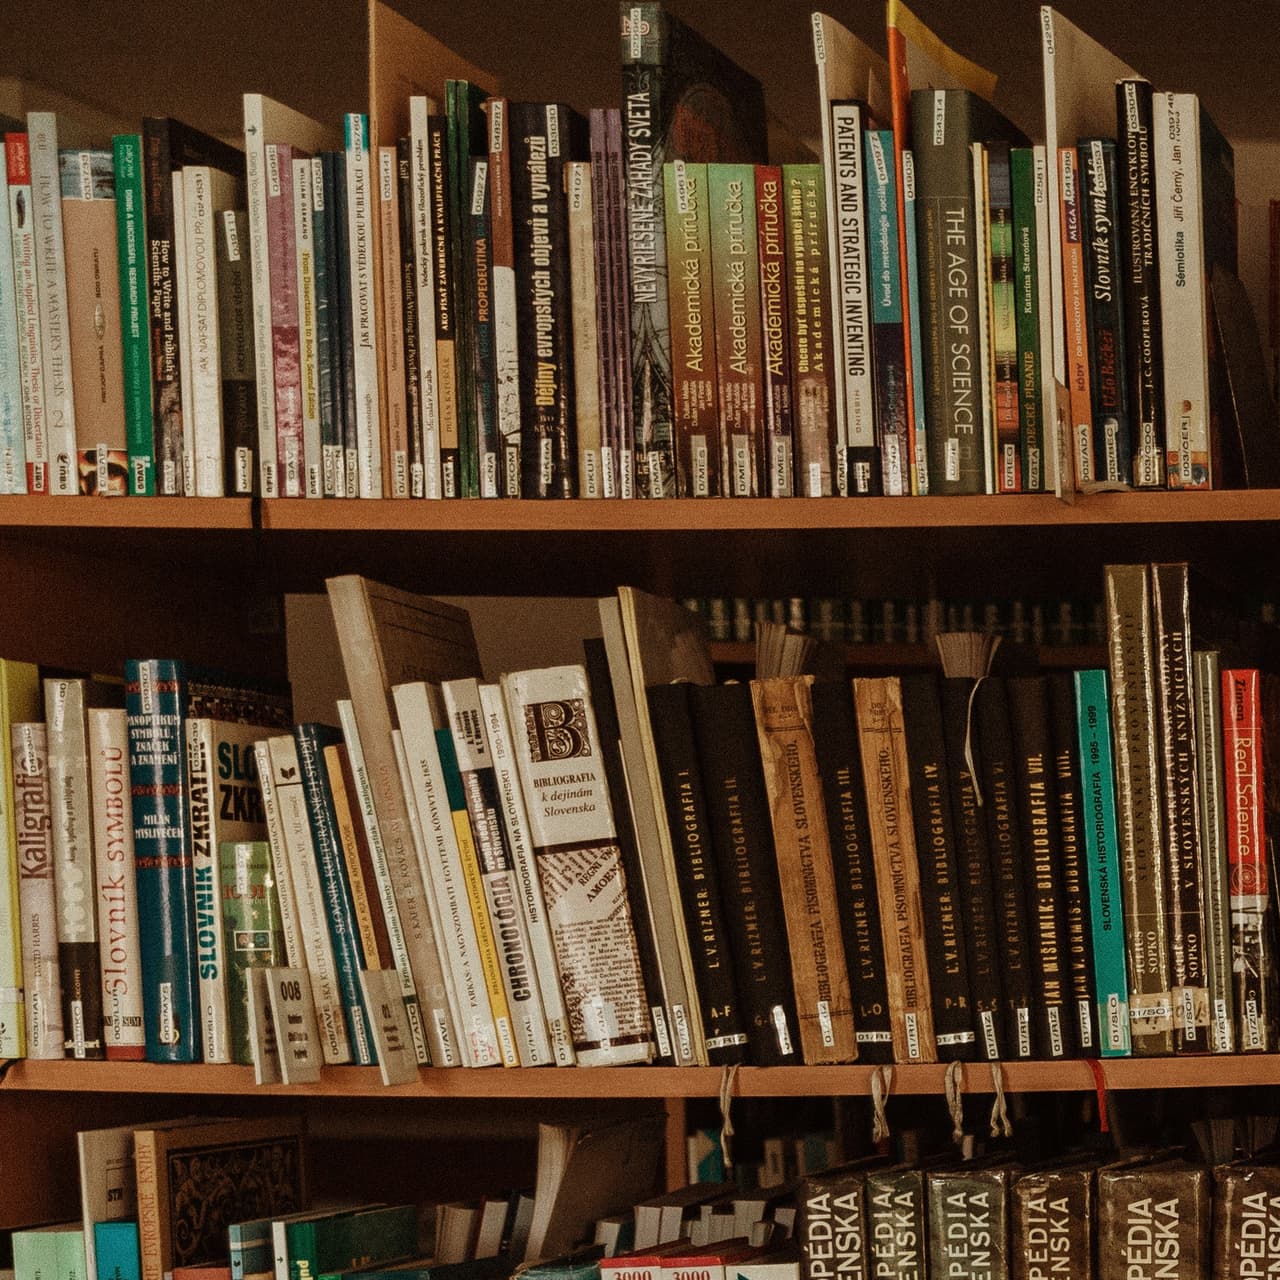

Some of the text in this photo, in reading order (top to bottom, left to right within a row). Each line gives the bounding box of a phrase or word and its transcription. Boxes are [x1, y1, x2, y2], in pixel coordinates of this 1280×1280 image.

[730, 180, 746, 374] Akademická príručka
[838, 116, 865, 377] PATENTS AND STRATEGIC INVENTING
[945, 207, 974, 435] THE AGE OF SCIENCE
[533, 772, 595, 788] BIBLIOGRAFIA
[544, 803, 596, 818] Slovenska
[553, 788, 592, 803] dejinám
[1236, 736, 1251, 856] Real Science
[490, 874, 532, 1004] CHRONOLÓGIA
